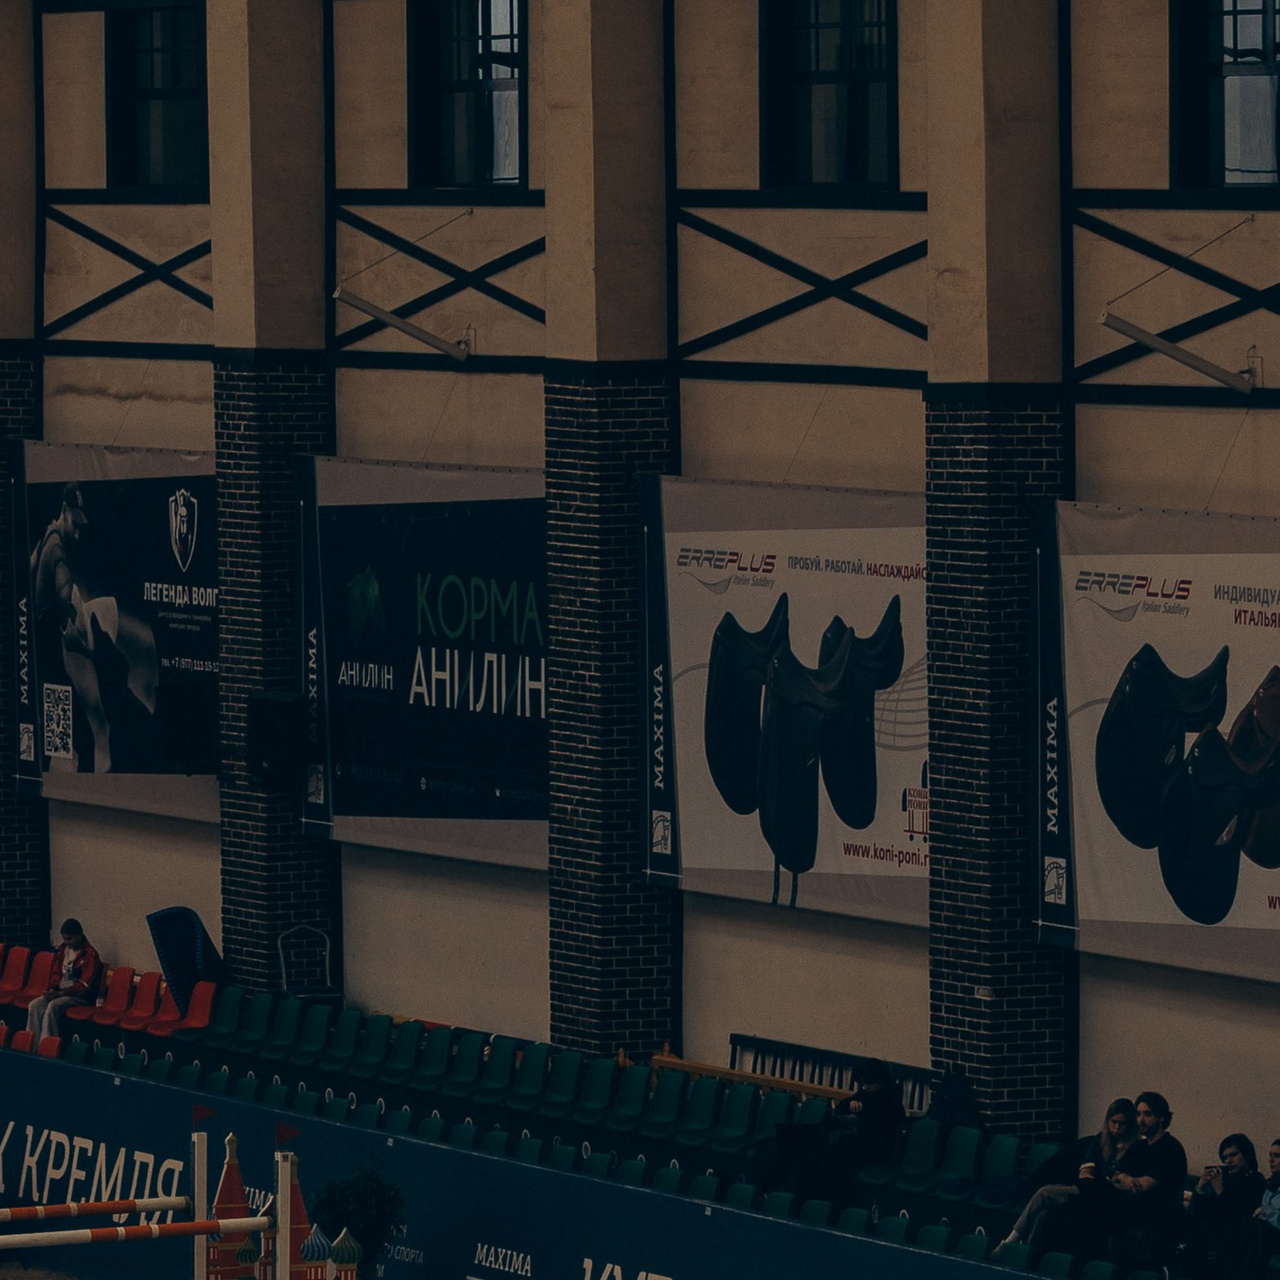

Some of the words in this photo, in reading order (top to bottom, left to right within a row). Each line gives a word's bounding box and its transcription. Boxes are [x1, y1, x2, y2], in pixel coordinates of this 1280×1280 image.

[677, 548, 777, 574] ERREPLUS
[787, 555, 823, 572] ПРОБУЙ.
[825, 559, 865, 576] РАБОТАЙ.
[143, 582, 190, 608] ЛЕГЕНДА
[192, 586, 219, 607] ВОЛГ
[1075, 571, 1193, 600] ERREPLUS
[417, 571, 544, 647] КОРМА
[1234, 609, 1280, 629] ИТАЛЬЯ
[19, 597, 30, 706] MAXIMA
[308, 628, 318, 743] MAXIMA
[338, 661, 394, 690] АНИЛИН
[408, 645, 546, 719] АНИЛИН
[654, 664, 664, 790] MAXIMA
[1047, 697, 1059, 835] MAXIMA
[843, 842, 929, 868] www.koni-poni.r
[1267, 895, 1280, 910] w
[18, 1125, 185, 1225] КРЕМЛЯ
[474, 1242, 533, 1277] MAXIMA
